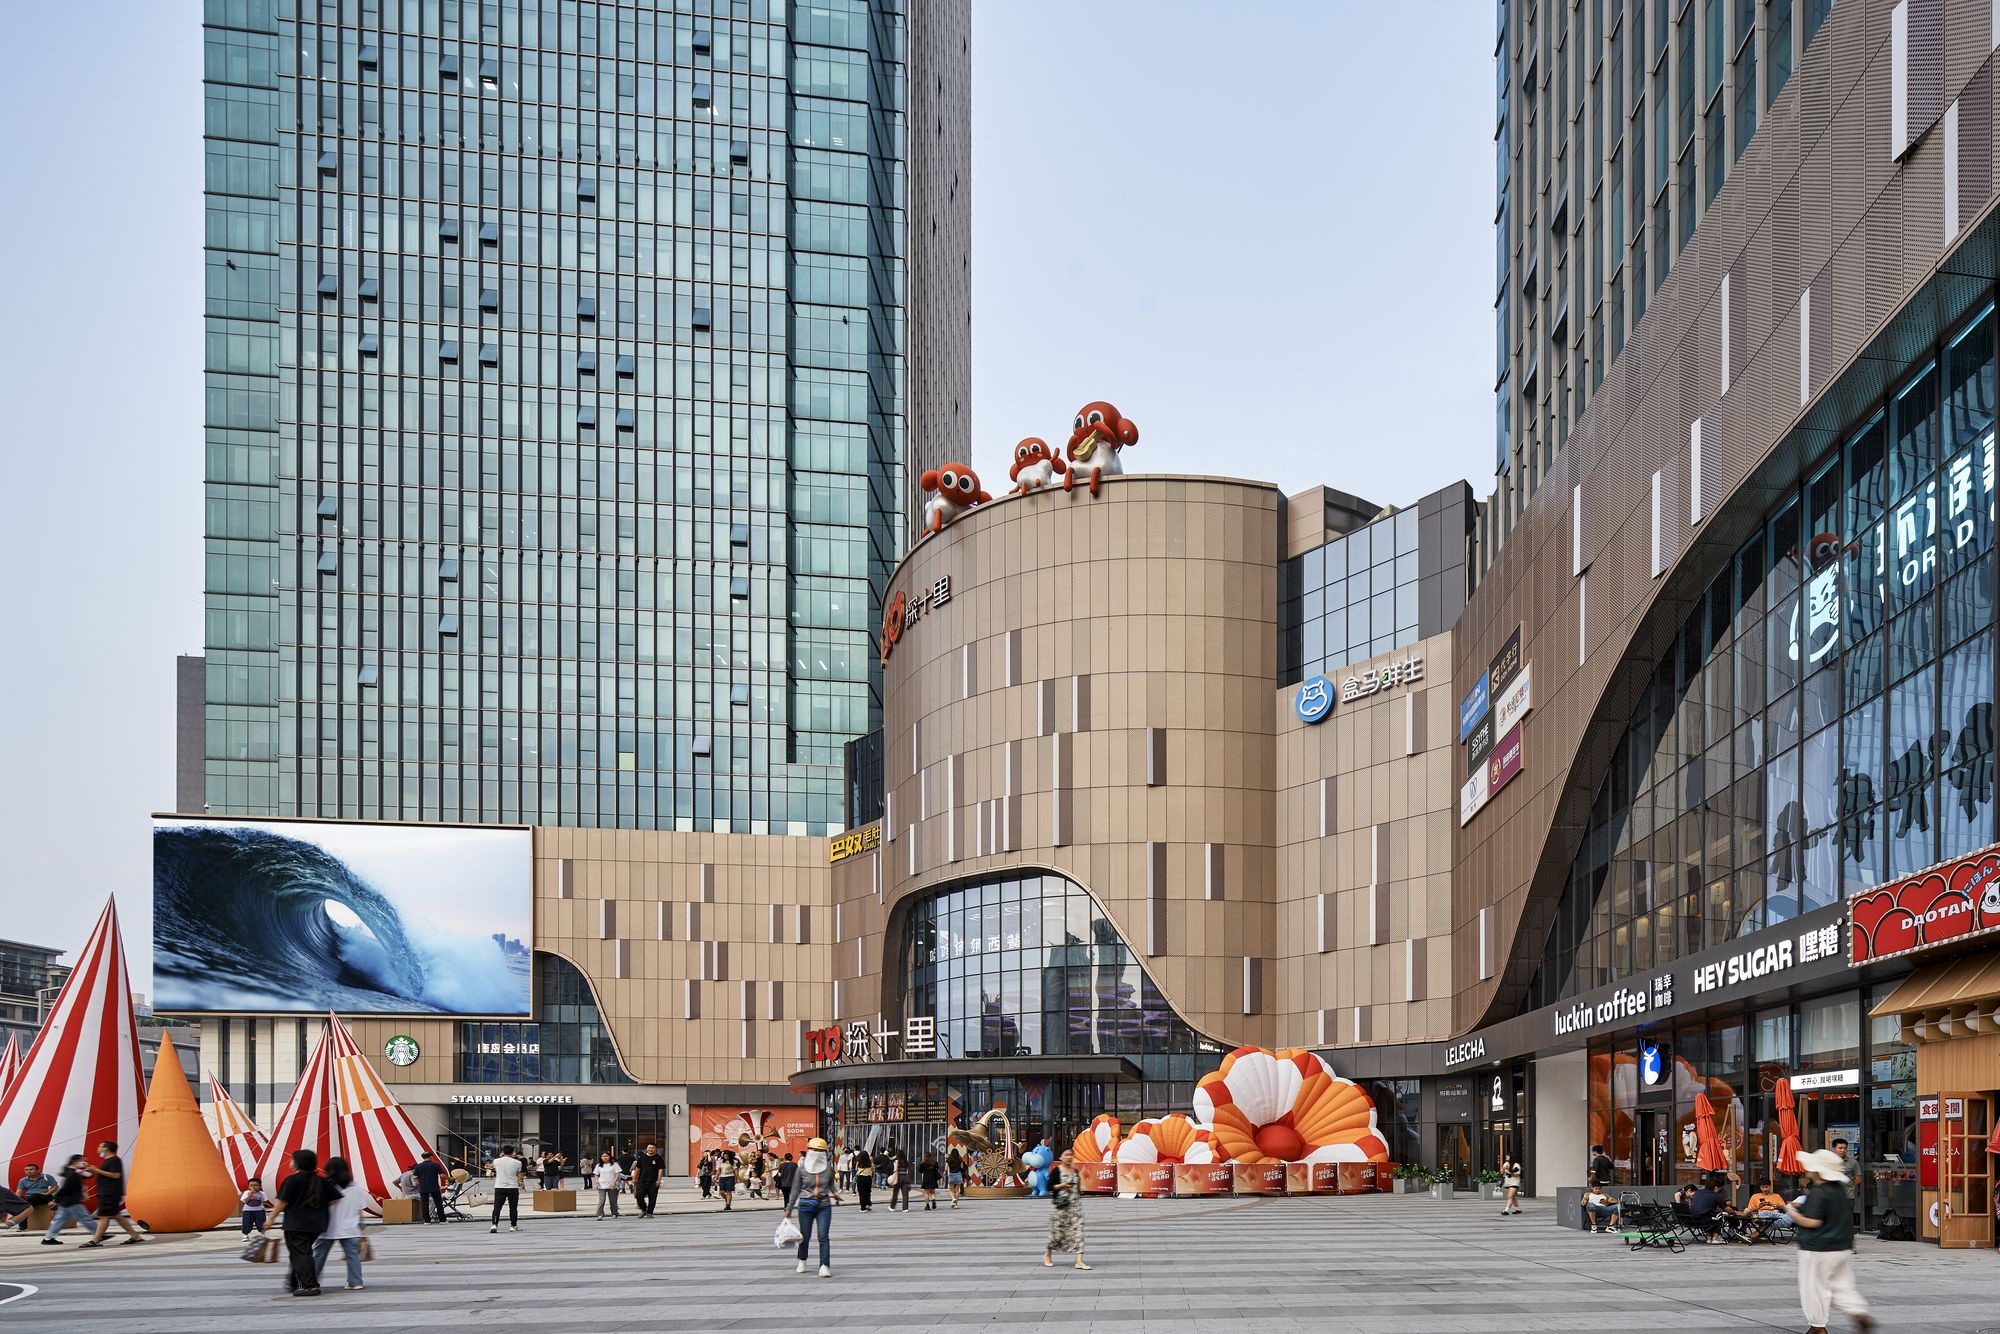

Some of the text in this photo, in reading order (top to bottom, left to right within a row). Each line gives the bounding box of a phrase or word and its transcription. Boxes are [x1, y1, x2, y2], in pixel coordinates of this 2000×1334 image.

[1341, 656, 1423, 704] 盒马鲜生
[1901, 899, 1974, 930] DAOTAN
[1694, 961, 1726, 994] HEY
[1728, 939, 1793, 985] SUGAR
[1654, 974, 1672, 992] 瑞幸
[1555, 988, 1646, 1036] luckin coffee
[1654, 991, 1672, 1008] 咖啡
[846, 1016, 936, 1057] 探十里
[1445, 1037, 1485, 1067] LELECHA
[451, 1095, 573, 1104] STARBUCKS COFFEE
